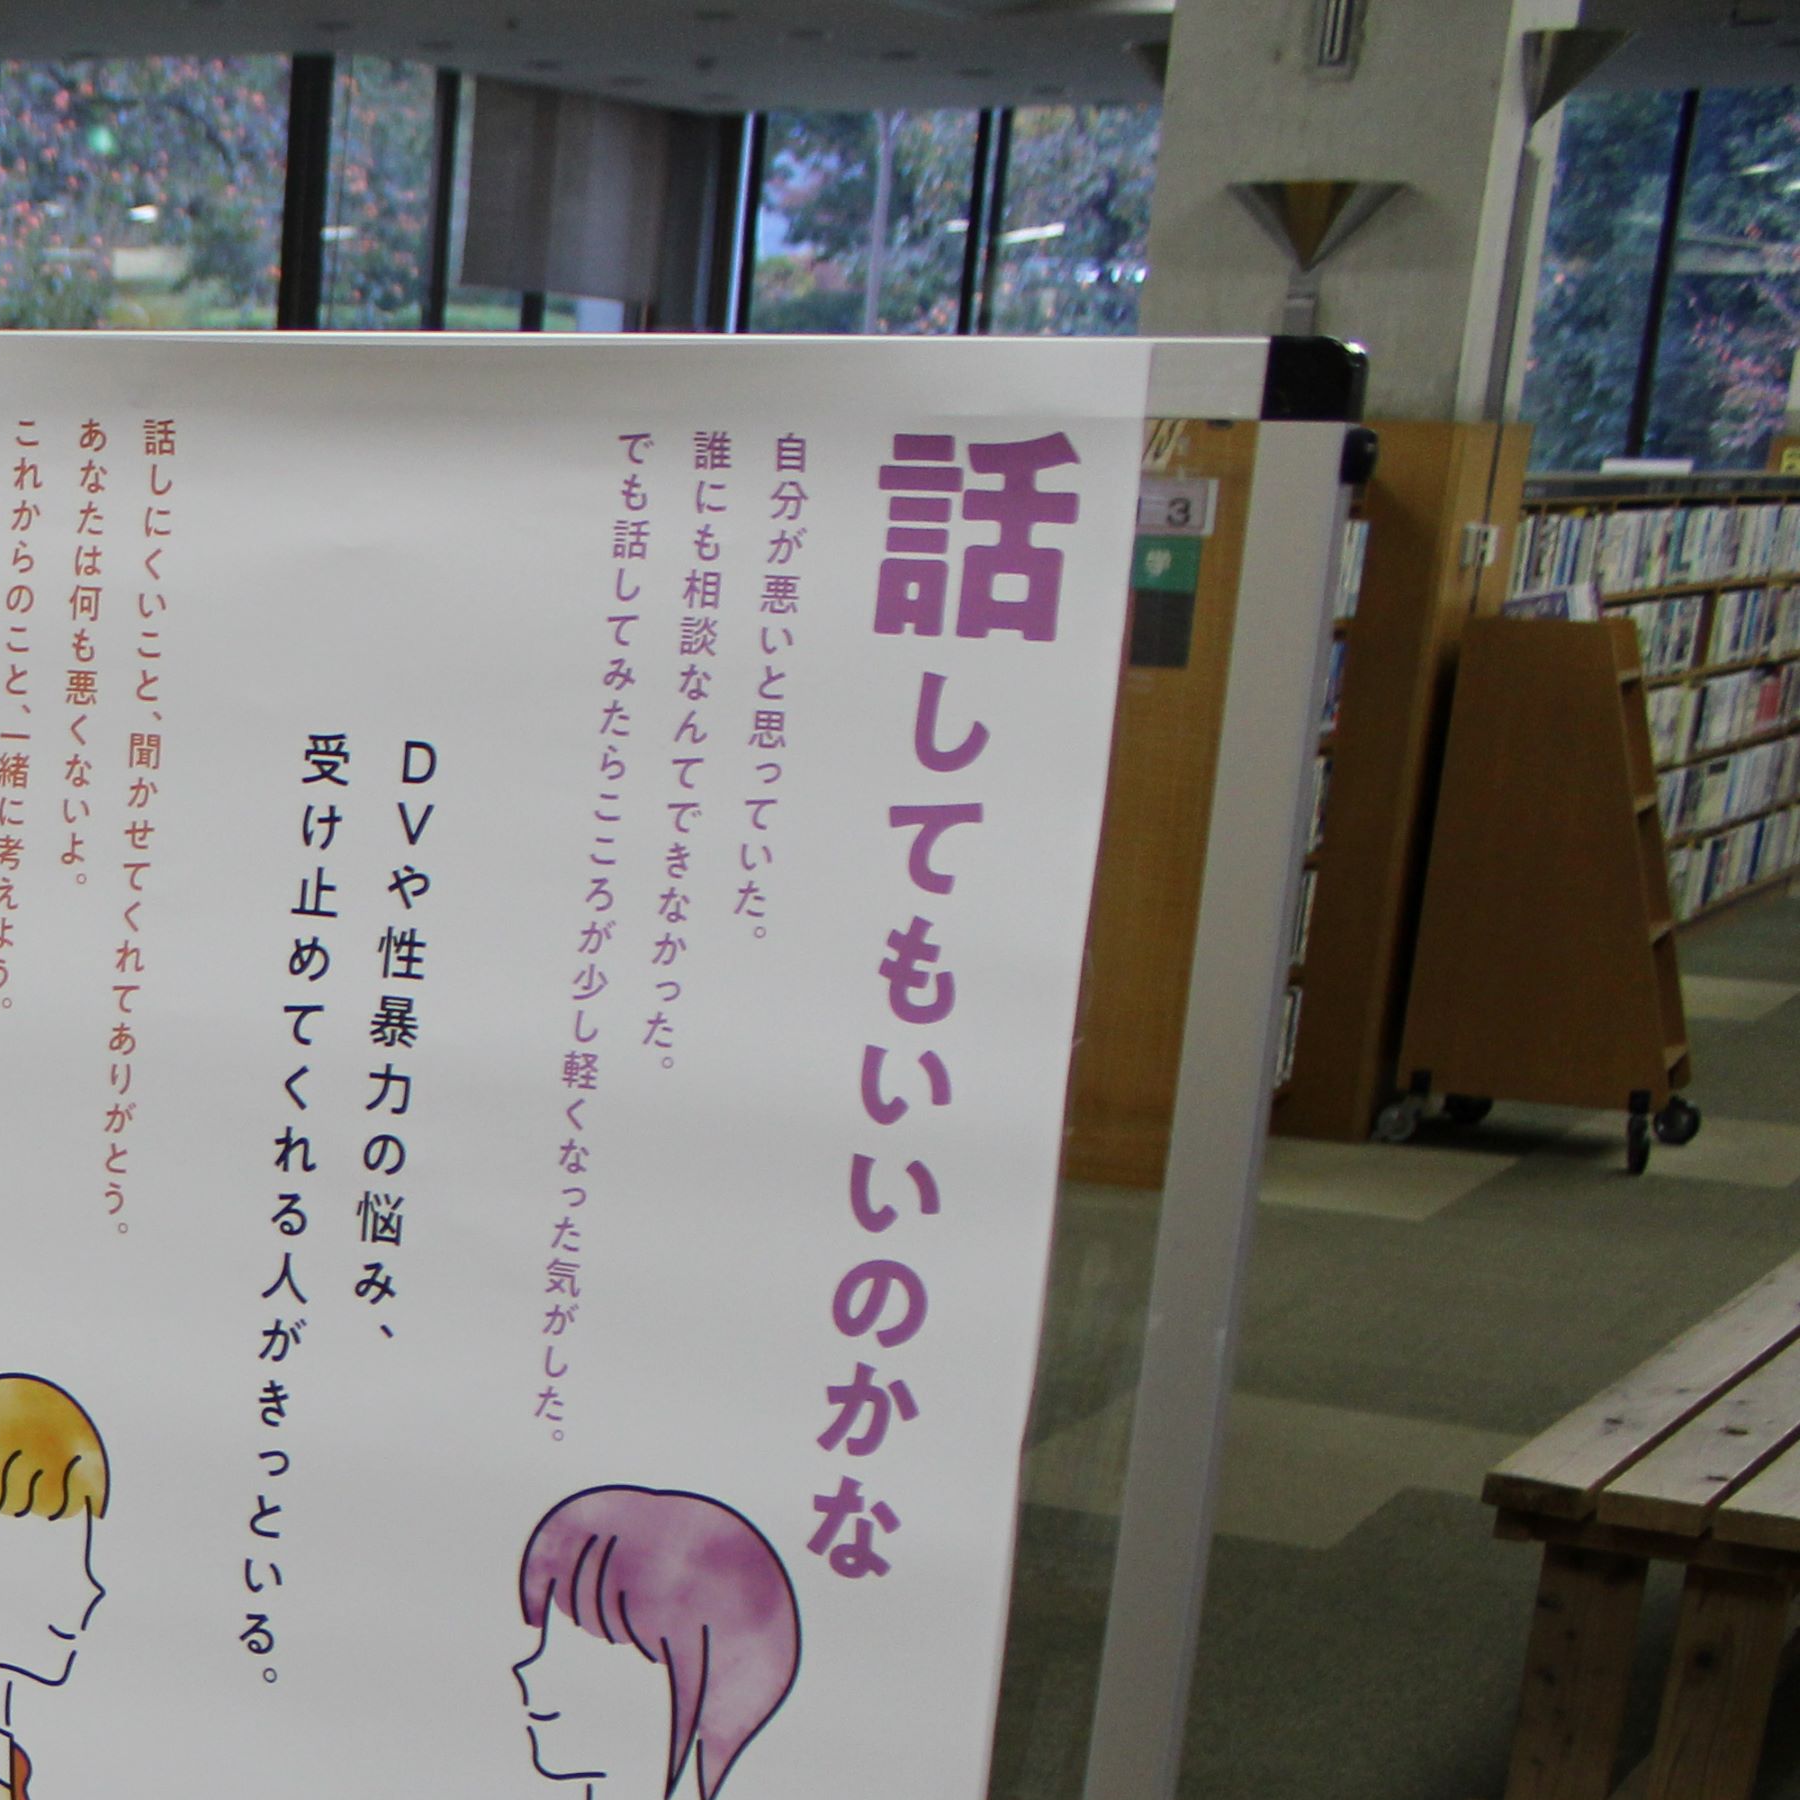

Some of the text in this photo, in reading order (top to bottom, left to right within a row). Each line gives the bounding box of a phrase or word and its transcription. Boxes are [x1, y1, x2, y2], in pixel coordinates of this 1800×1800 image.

[61, 417, 108, 886] あなたは何も悪くないよ。
[103, 418, 177, 1235] 話しにくいこと、聞かせてくれてありがとう。
[642, 431, 732, 1070] 誰にも相談なんてできなかった。
[733, 434, 809, 939] 自分が悪いと思っていた。
[1167, 497, 1191, 527] 3
[239, 733, 350, 1684] 受け止めてくれる人がきっといる。
[353, 740, 437, 1339] DVや性暴力の悩み、
[535, 432, 654, 1443] でも話してみたらこころが少し軽くなった気がした。
[806, 431, 1081, 1579] 話してもいいのかな
